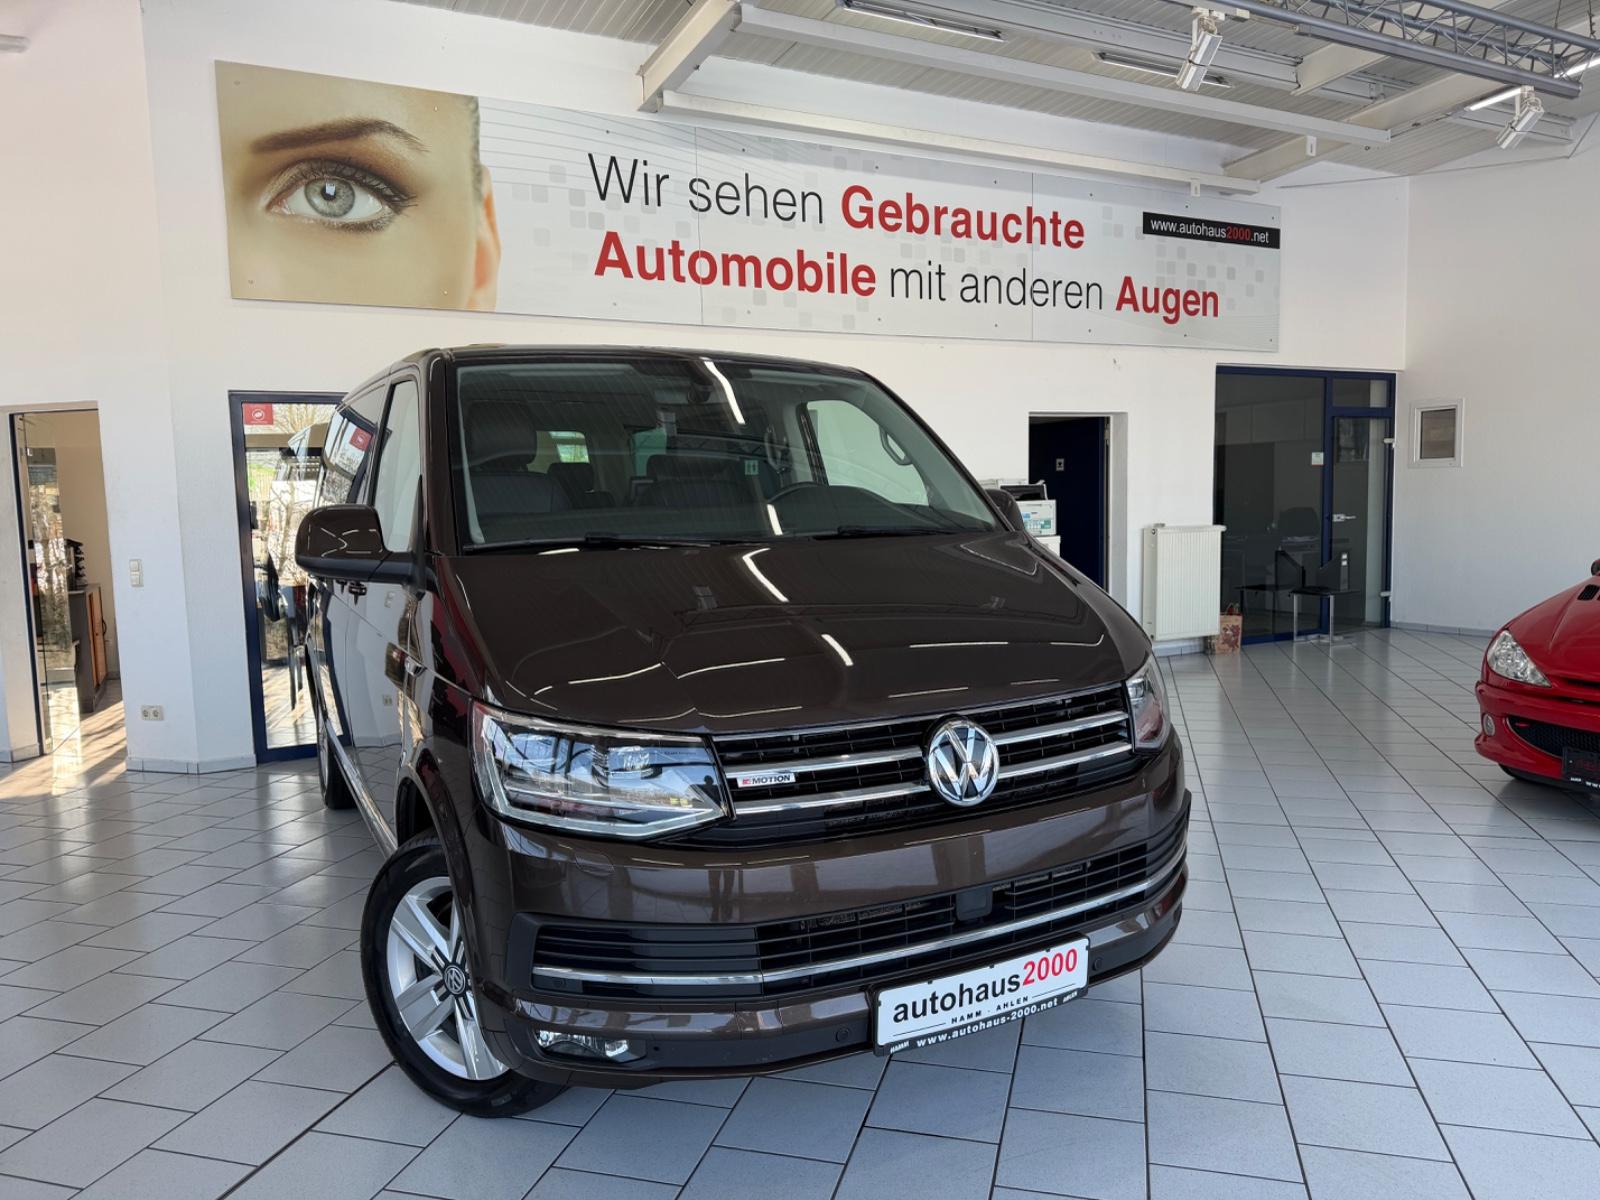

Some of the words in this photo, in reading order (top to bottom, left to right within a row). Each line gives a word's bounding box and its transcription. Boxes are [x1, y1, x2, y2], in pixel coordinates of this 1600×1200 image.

[588, 153, 669, 207] Wir
[689, 173, 823, 224] sehen
[841, 185, 1085, 249] Gebrauchte
[1150, 219, 1270, 244] www.autohaus2000.net
[594, 231, 876, 297] Automobile
[890, 260, 946, 301] mit
[960, 268, 1102, 310] anderen
[1116, 276, 1219, 324] Augen
[893, 948, 1078, 1023] autohaus2000
[951, 1010, 982, 1025] HAMM
[996, 995, 1029, 1012] AHLEN
[916, 998, 1058, 1048] www.autohaus-2000.net
